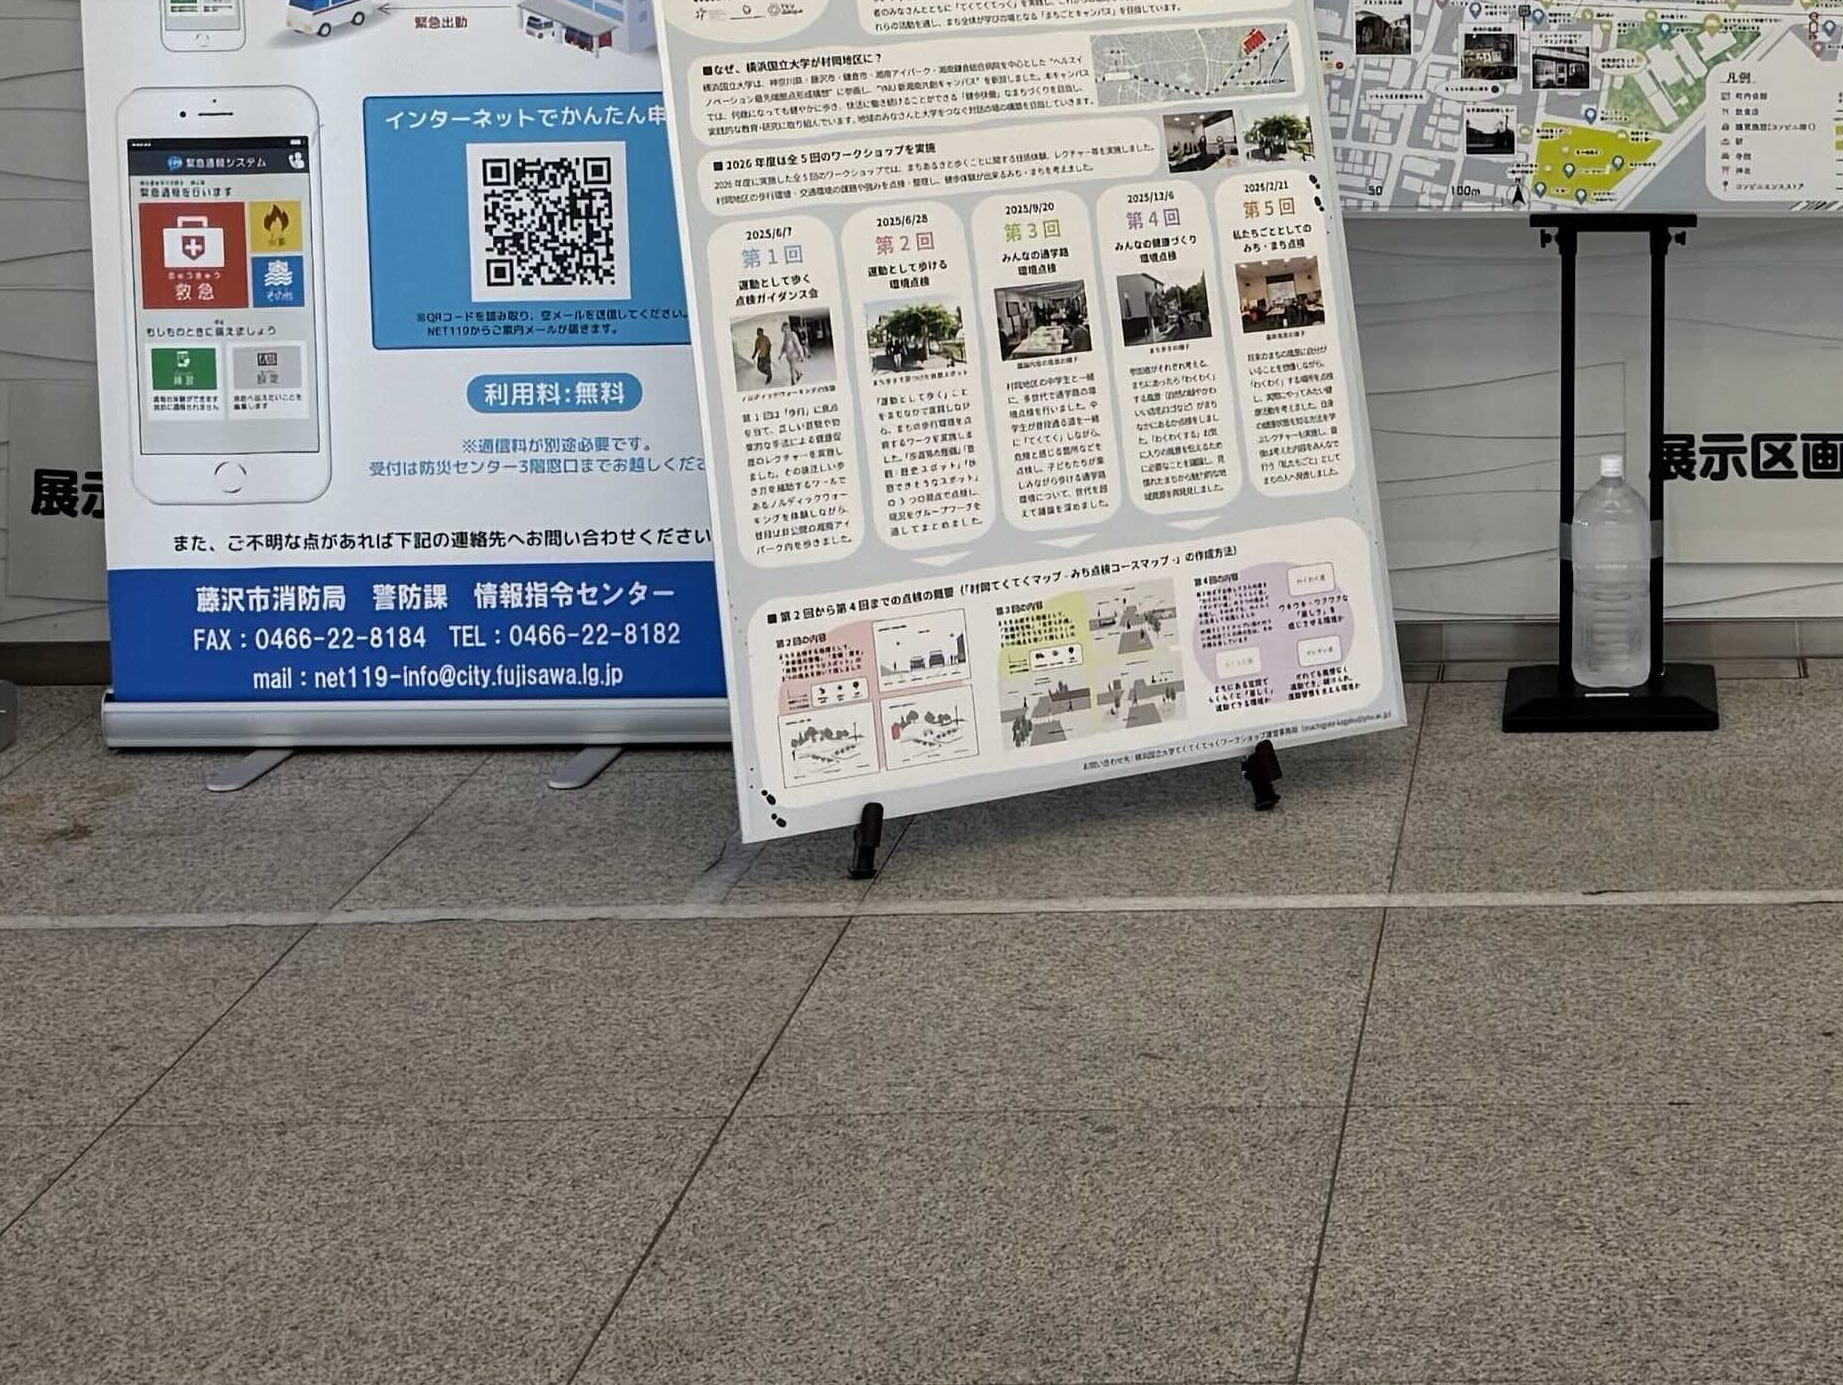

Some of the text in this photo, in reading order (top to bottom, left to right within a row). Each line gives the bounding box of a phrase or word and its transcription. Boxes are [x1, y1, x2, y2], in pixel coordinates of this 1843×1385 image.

[414, 14, 468, 30] 緊急出動
[195, 582, 348, 613] 藤沢市消防局
[371, 582, 449, 612] 警防課
[473, 580, 677, 610] 情報指令センター
